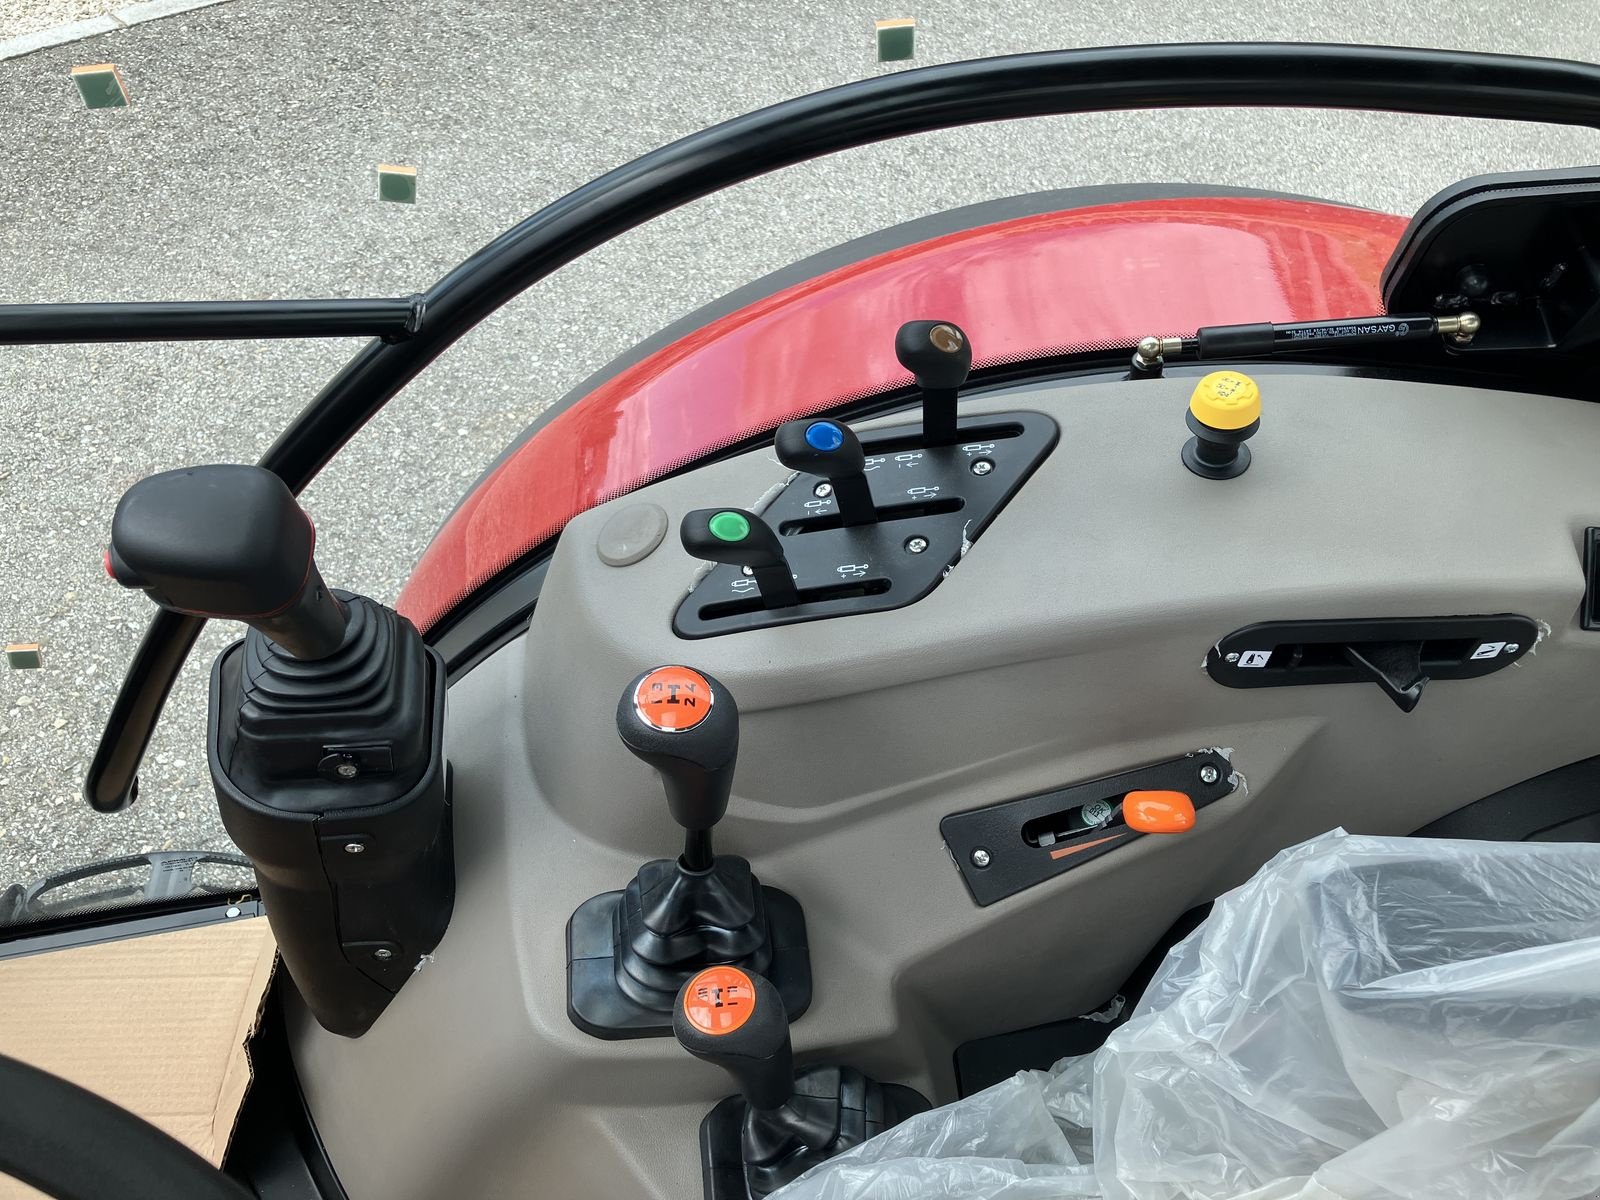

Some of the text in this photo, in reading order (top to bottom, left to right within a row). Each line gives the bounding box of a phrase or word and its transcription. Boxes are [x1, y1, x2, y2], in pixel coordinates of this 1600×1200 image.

[1357, 323, 1396, 335] GAYSAN
[651, 682, 663, 691] 3
[684, 683, 696, 708] 2 4
